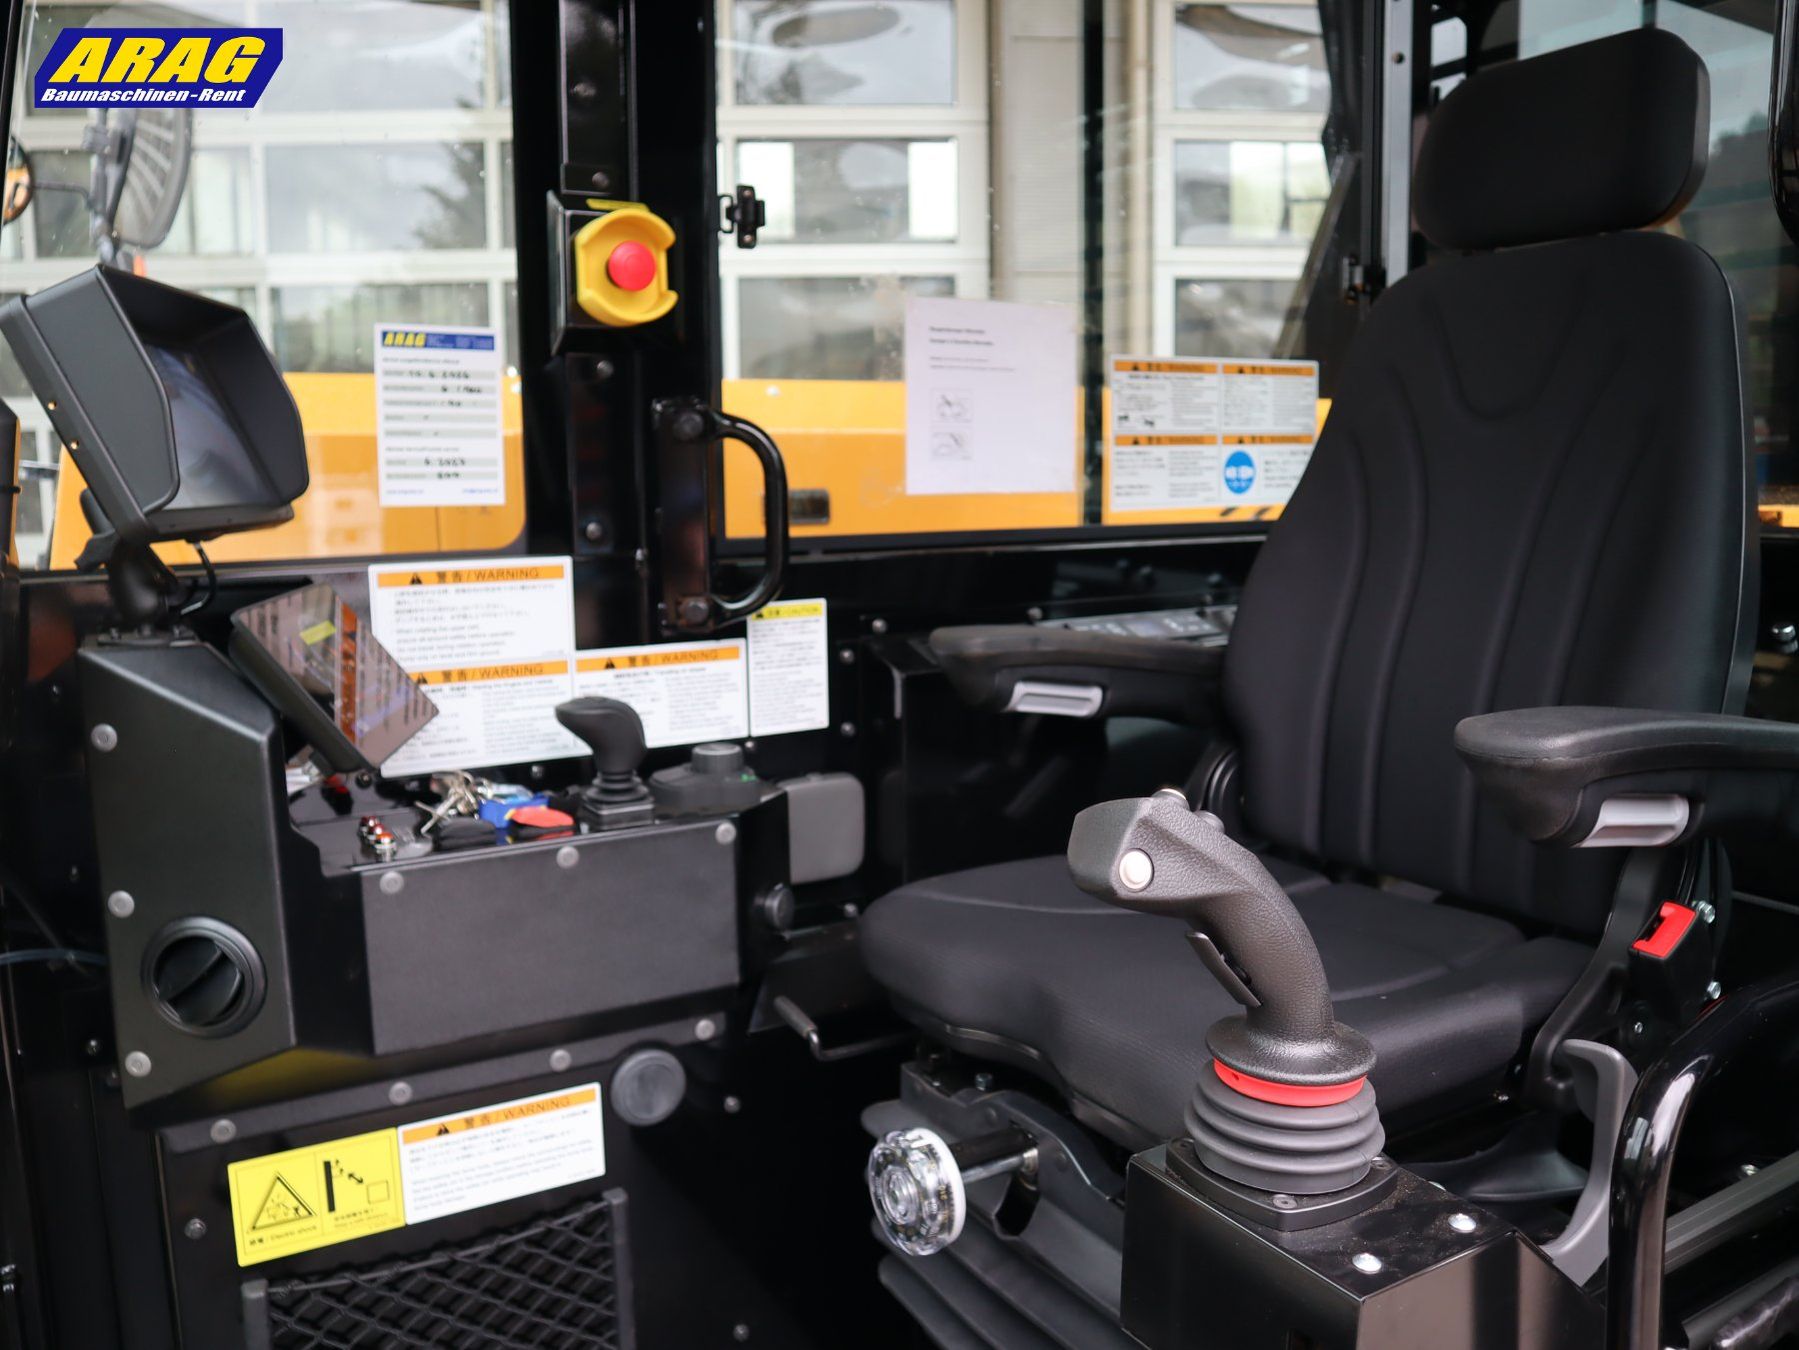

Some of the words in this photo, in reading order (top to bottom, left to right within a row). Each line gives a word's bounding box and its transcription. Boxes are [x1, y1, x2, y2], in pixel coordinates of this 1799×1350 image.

[474, 566, 540, 581] WARNING
[479, 663, 544, 678] WARNING
[502, 1095, 572, 1120] WARNING
